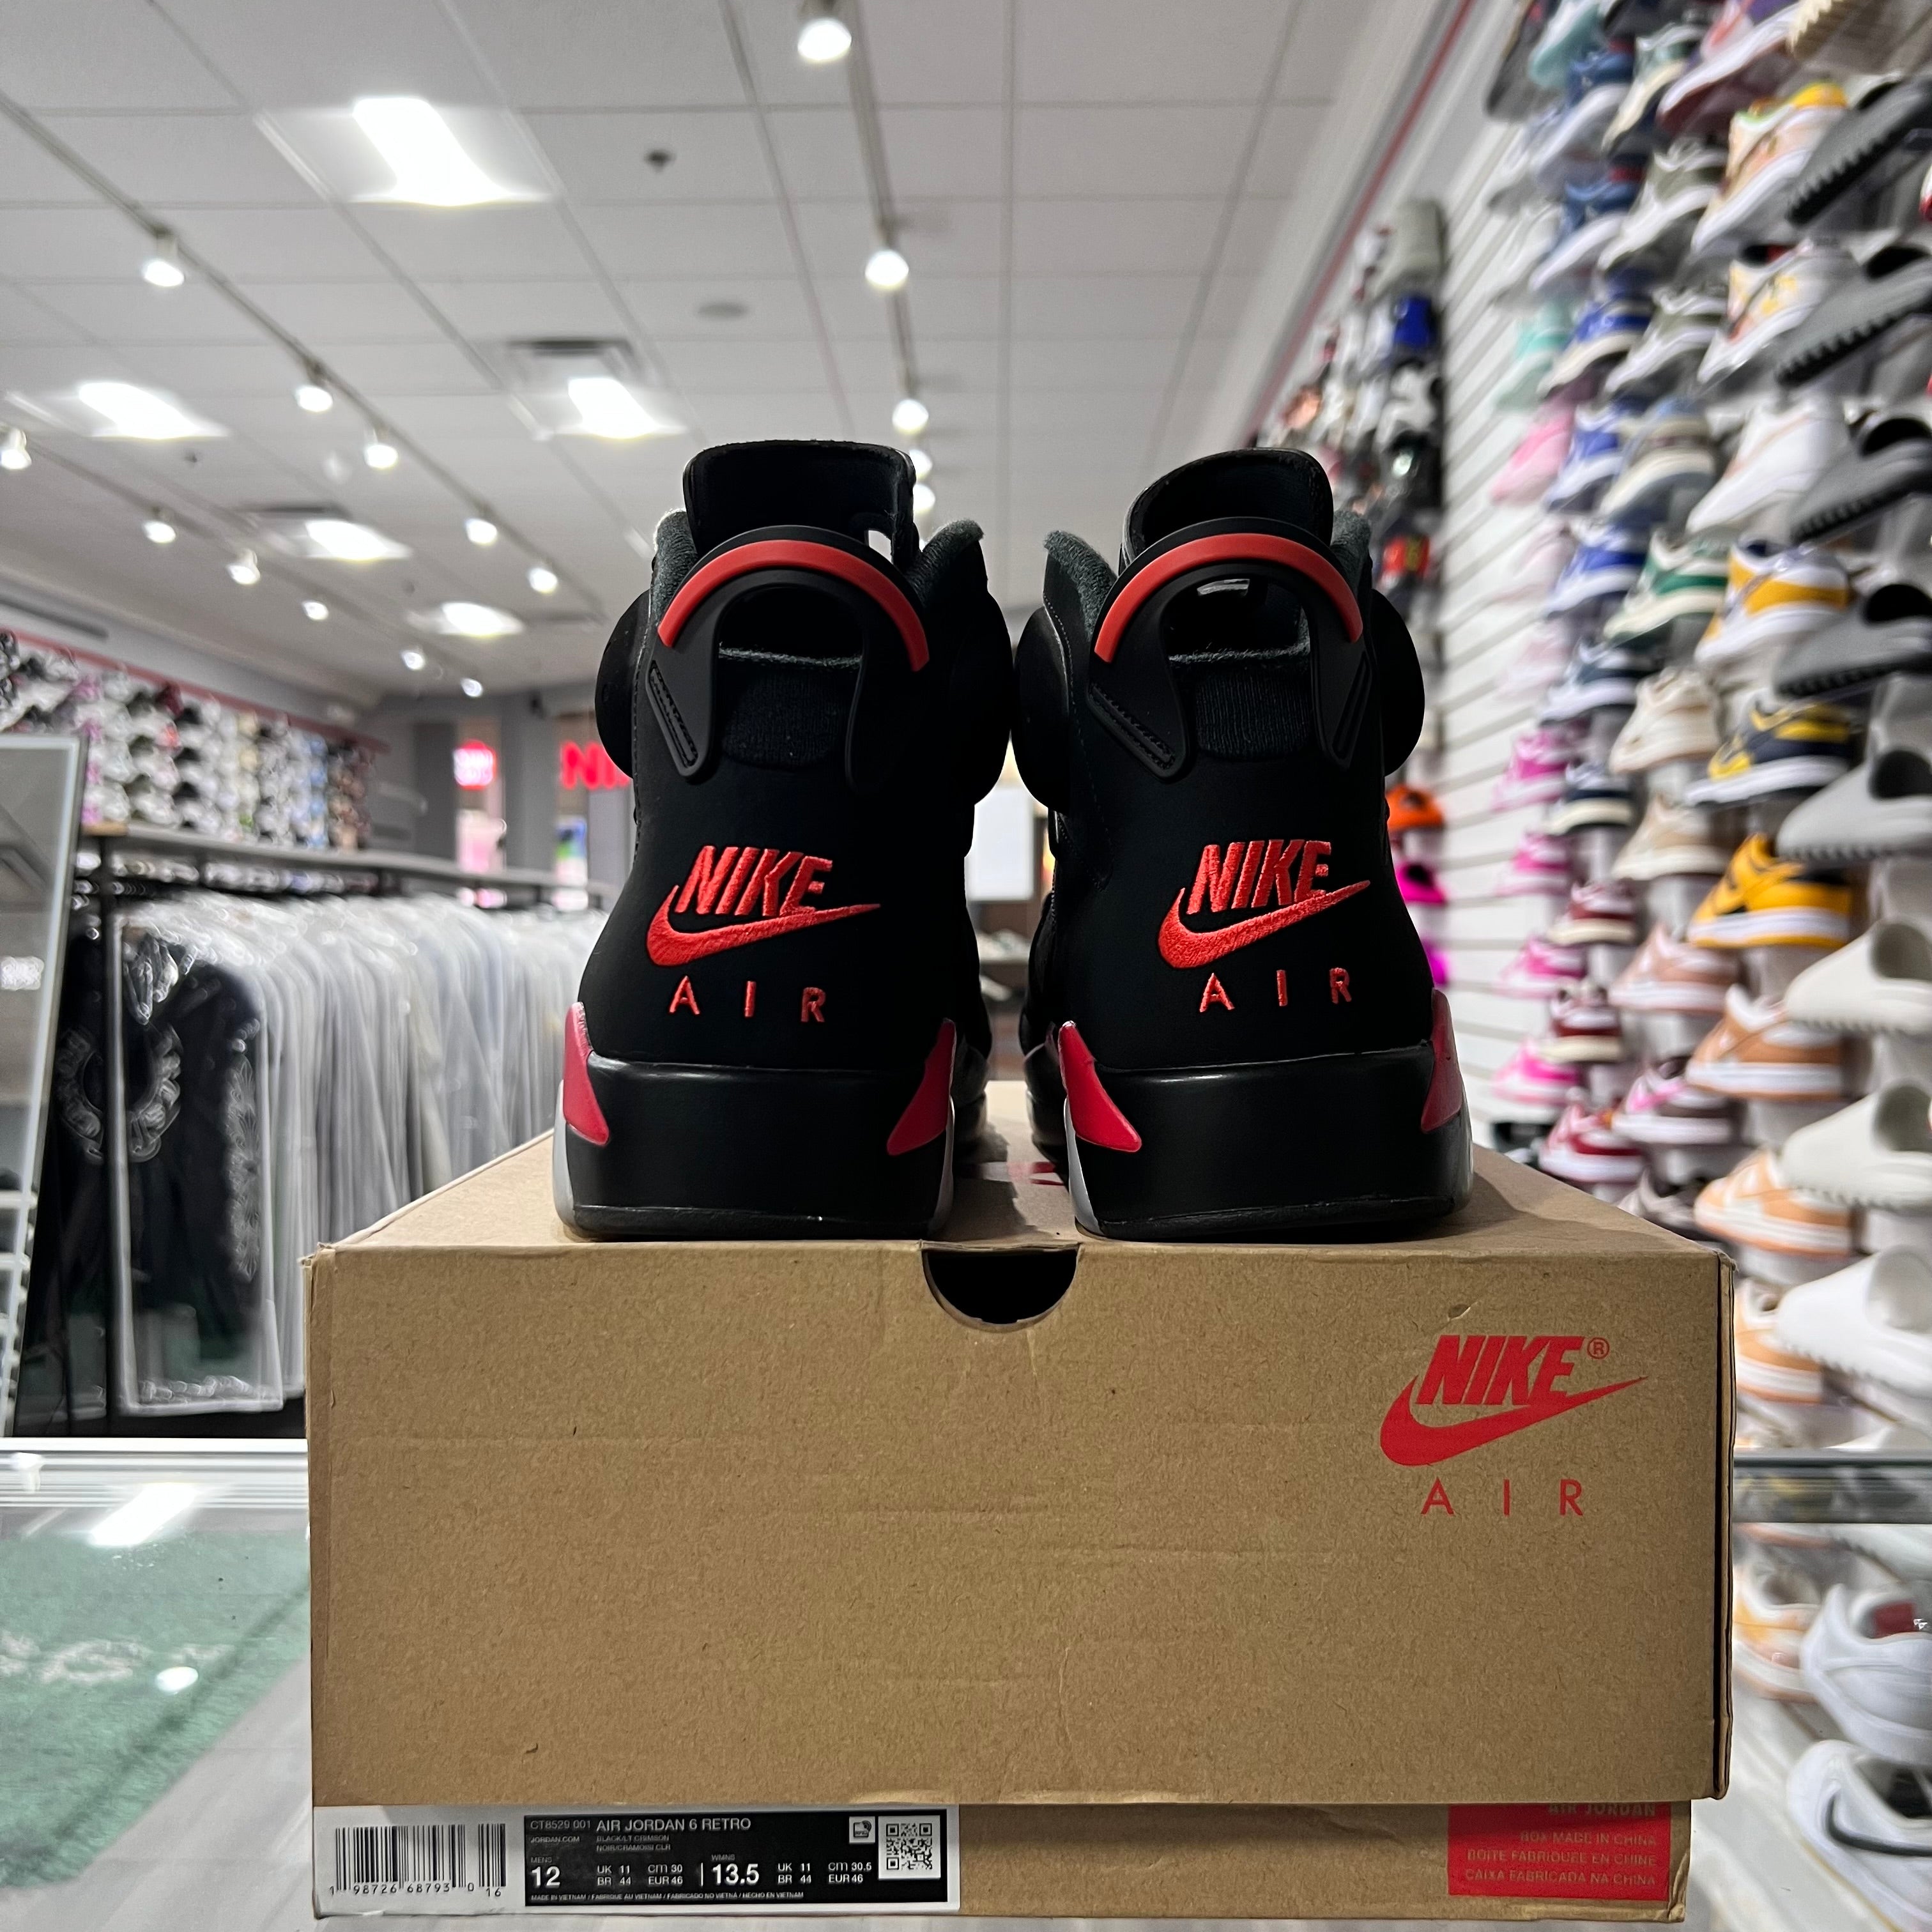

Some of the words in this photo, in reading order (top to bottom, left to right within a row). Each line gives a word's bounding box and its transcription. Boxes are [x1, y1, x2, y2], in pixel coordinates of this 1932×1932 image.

[674, 845, 833, 916] NIKE
[1186, 839, 1331, 914] NIKE
[1199, 967, 1352, 1013] AIR
[668, 975, 826, 1023] AIR
[1415, 1334, 1586, 1406] NIKE
[1420, 1476, 1584, 1517] AIR
[530, 1820, 571, 1830] CT8529
[573, 1820, 590, 1828] 001
[596, 1820, 620, 1831] AIR
[625, 1819, 685, 1831] JORDAN
[689, 1819, 698, 1830] 6
[702, 1818, 751, 1830] RETRO
[1552, 1831, 1591, 1844] MADE
[1596, 1832, 1609, 1844] IN
[1614, 1833, 1657, 1846] CHINA
[1591, 1853, 1609, 1864] EN
[1614, 1854, 1657, 1866] CHINE
[597, 1865, 612, 1874] UK
[619, 1865, 630, 1874] 11
[671, 1864, 683, 1873] 30
[778, 1862, 792, 1872] UK
[800, 1862, 810, 1871] 11
[851, 1862, 872, 1871] 30.5
[532, 1866, 560, 1887] 12
[648, 1876, 670, 1885] EUR
[671, 1876, 684, 1885] 46
[712, 1863, 760, 1885] 13.5
[778, 1874, 792, 1884] BR
[800, 1874, 811, 1883] 44
[828, 1874, 850, 1883] EUR
[851, 1874, 864, 1883] 46
[1465, 1868, 1505, 1881] CAIXA
[1509, 1869, 1586, 1882] FABRICADA
[1590, 1873, 1609, 1883] NA
[1613, 1873, 1656, 1885] CHINA
[597, 1876, 612, 1886] BR
[619, 1876, 631, 1885] 44
[353, 1884, 397, 1895] 98726
[406, 1883, 450, 1893] 68793
[486, 1887, 502, 1897] 16
